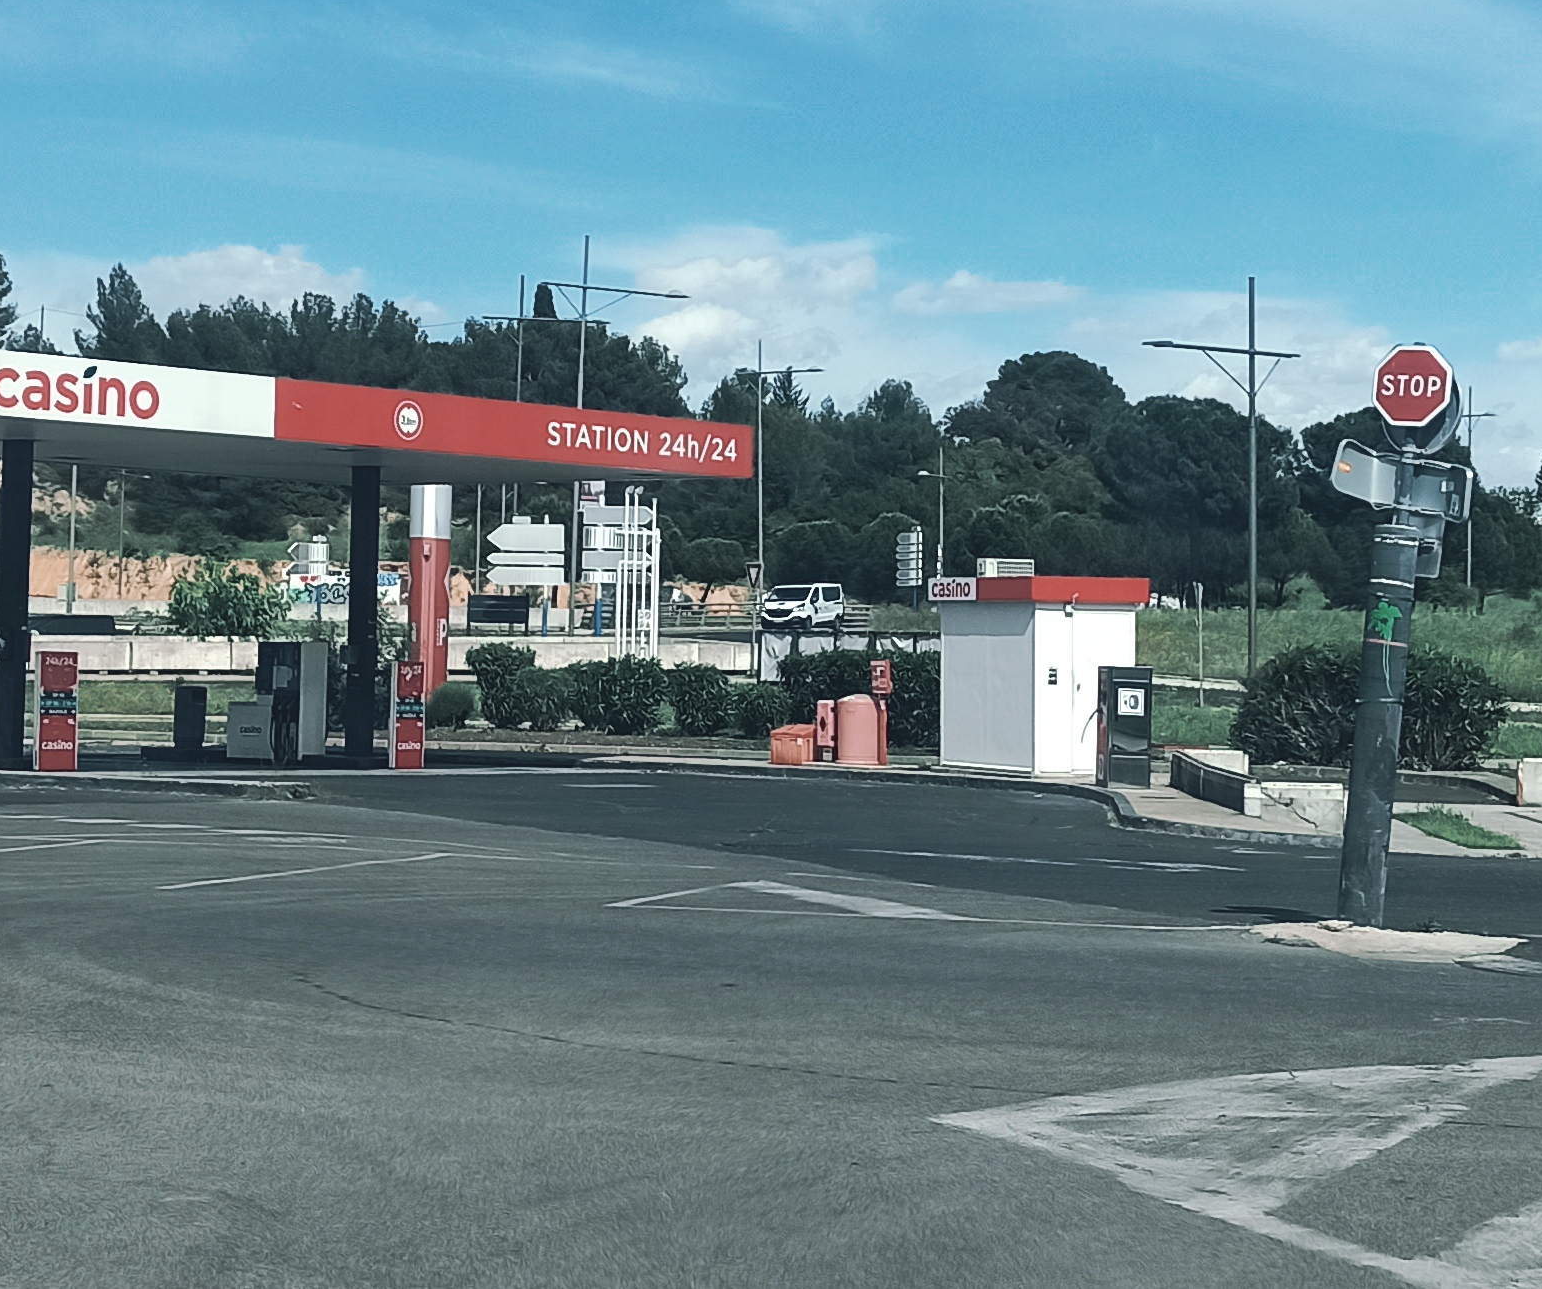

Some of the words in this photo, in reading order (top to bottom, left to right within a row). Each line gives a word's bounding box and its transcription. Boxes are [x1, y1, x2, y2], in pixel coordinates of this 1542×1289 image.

[1381, 374, 1442, 398] STOP
[547, 421, 649, 454] STATION
[658, 432, 738, 463] 24h/24
[931, 578, 971, 597] casino
[41, 740, 74, 750] casino
[397, 740, 421, 750] casino
